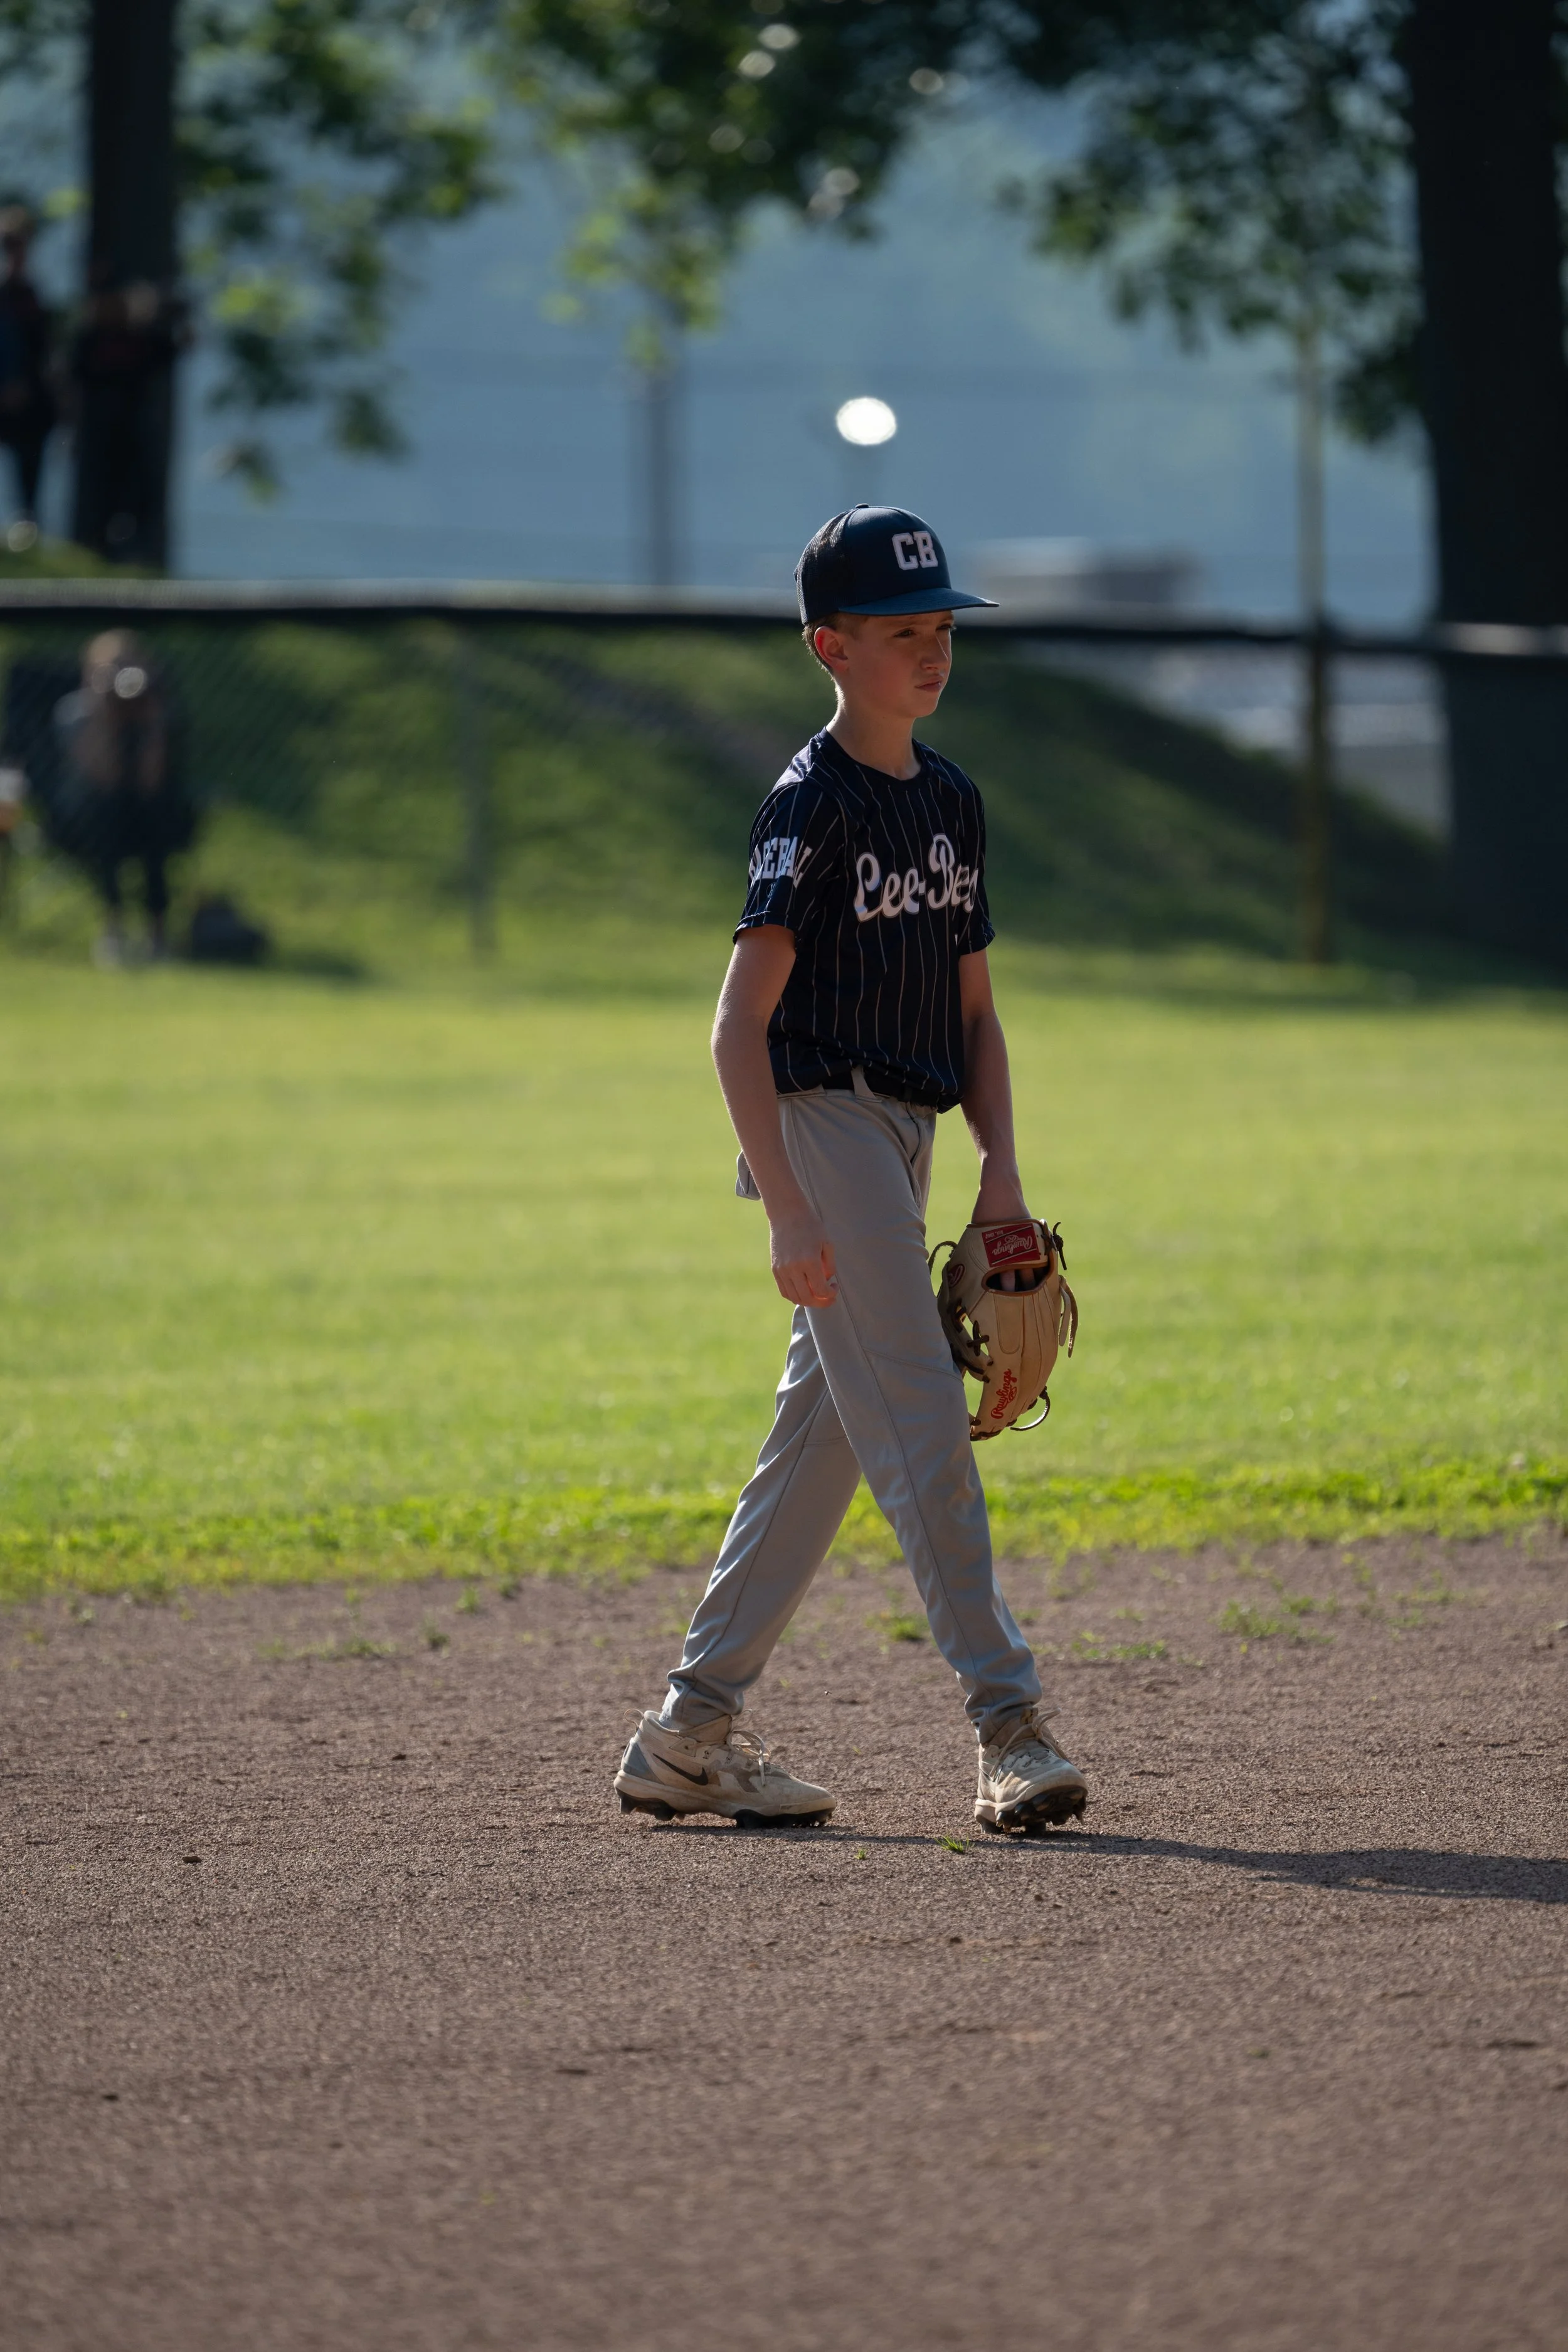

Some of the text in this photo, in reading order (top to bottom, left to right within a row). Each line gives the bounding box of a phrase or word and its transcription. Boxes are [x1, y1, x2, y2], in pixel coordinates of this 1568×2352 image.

[892, 531, 938, 571] CB
[992, 1235, 1033, 1255] Rawlings
[991, 1369, 1017, 1419] Rawlings
